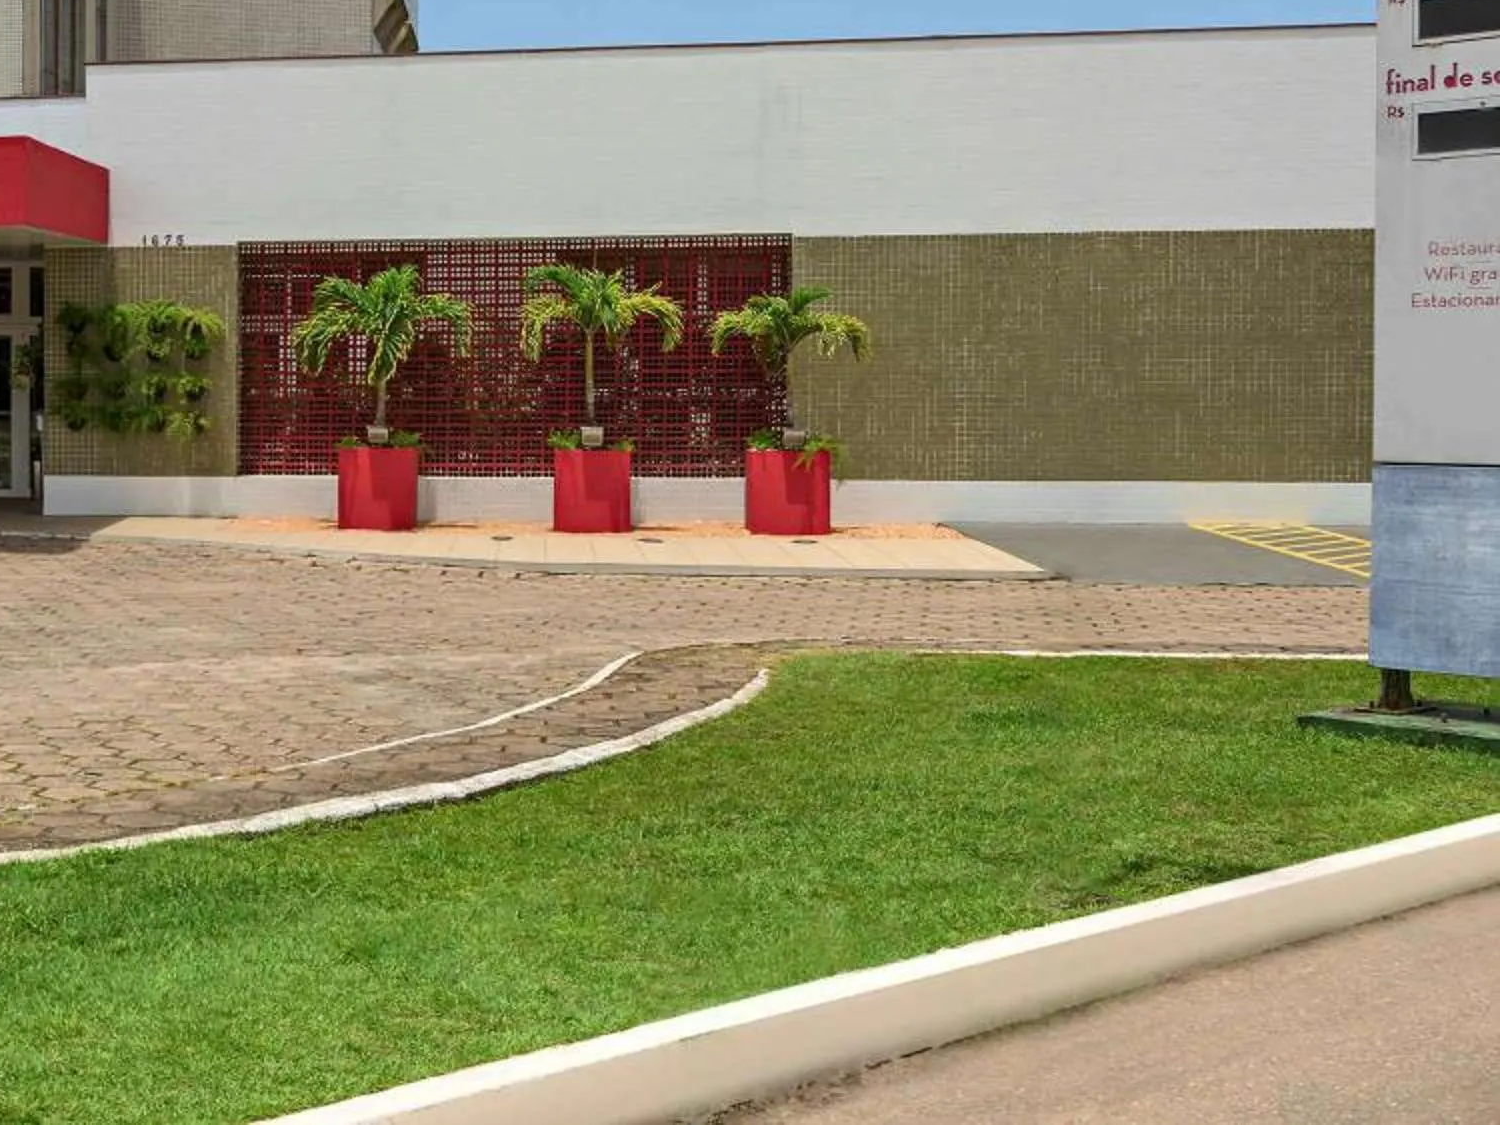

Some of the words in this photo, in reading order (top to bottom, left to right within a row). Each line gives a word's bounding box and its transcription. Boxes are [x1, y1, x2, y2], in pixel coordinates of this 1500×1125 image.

[1386, 64, 1435, 95] final
[1444, 63, 1473, 88] de
[1428, 241, 1500, 256] Restaur
